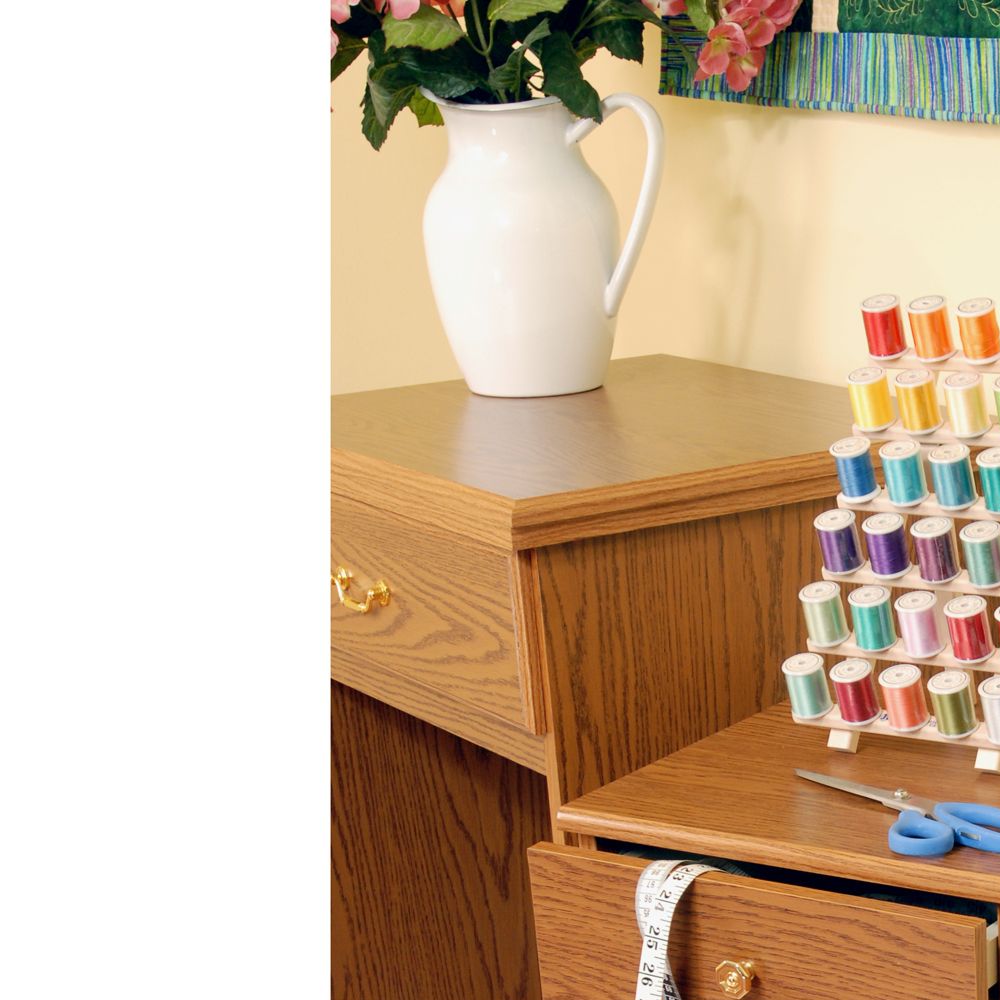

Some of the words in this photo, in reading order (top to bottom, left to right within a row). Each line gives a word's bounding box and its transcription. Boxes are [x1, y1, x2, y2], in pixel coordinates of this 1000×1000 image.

[654, 889, 672, 912] 24
[646, 925, 660, 950] 25
[641, 962, 655, 987] 26
